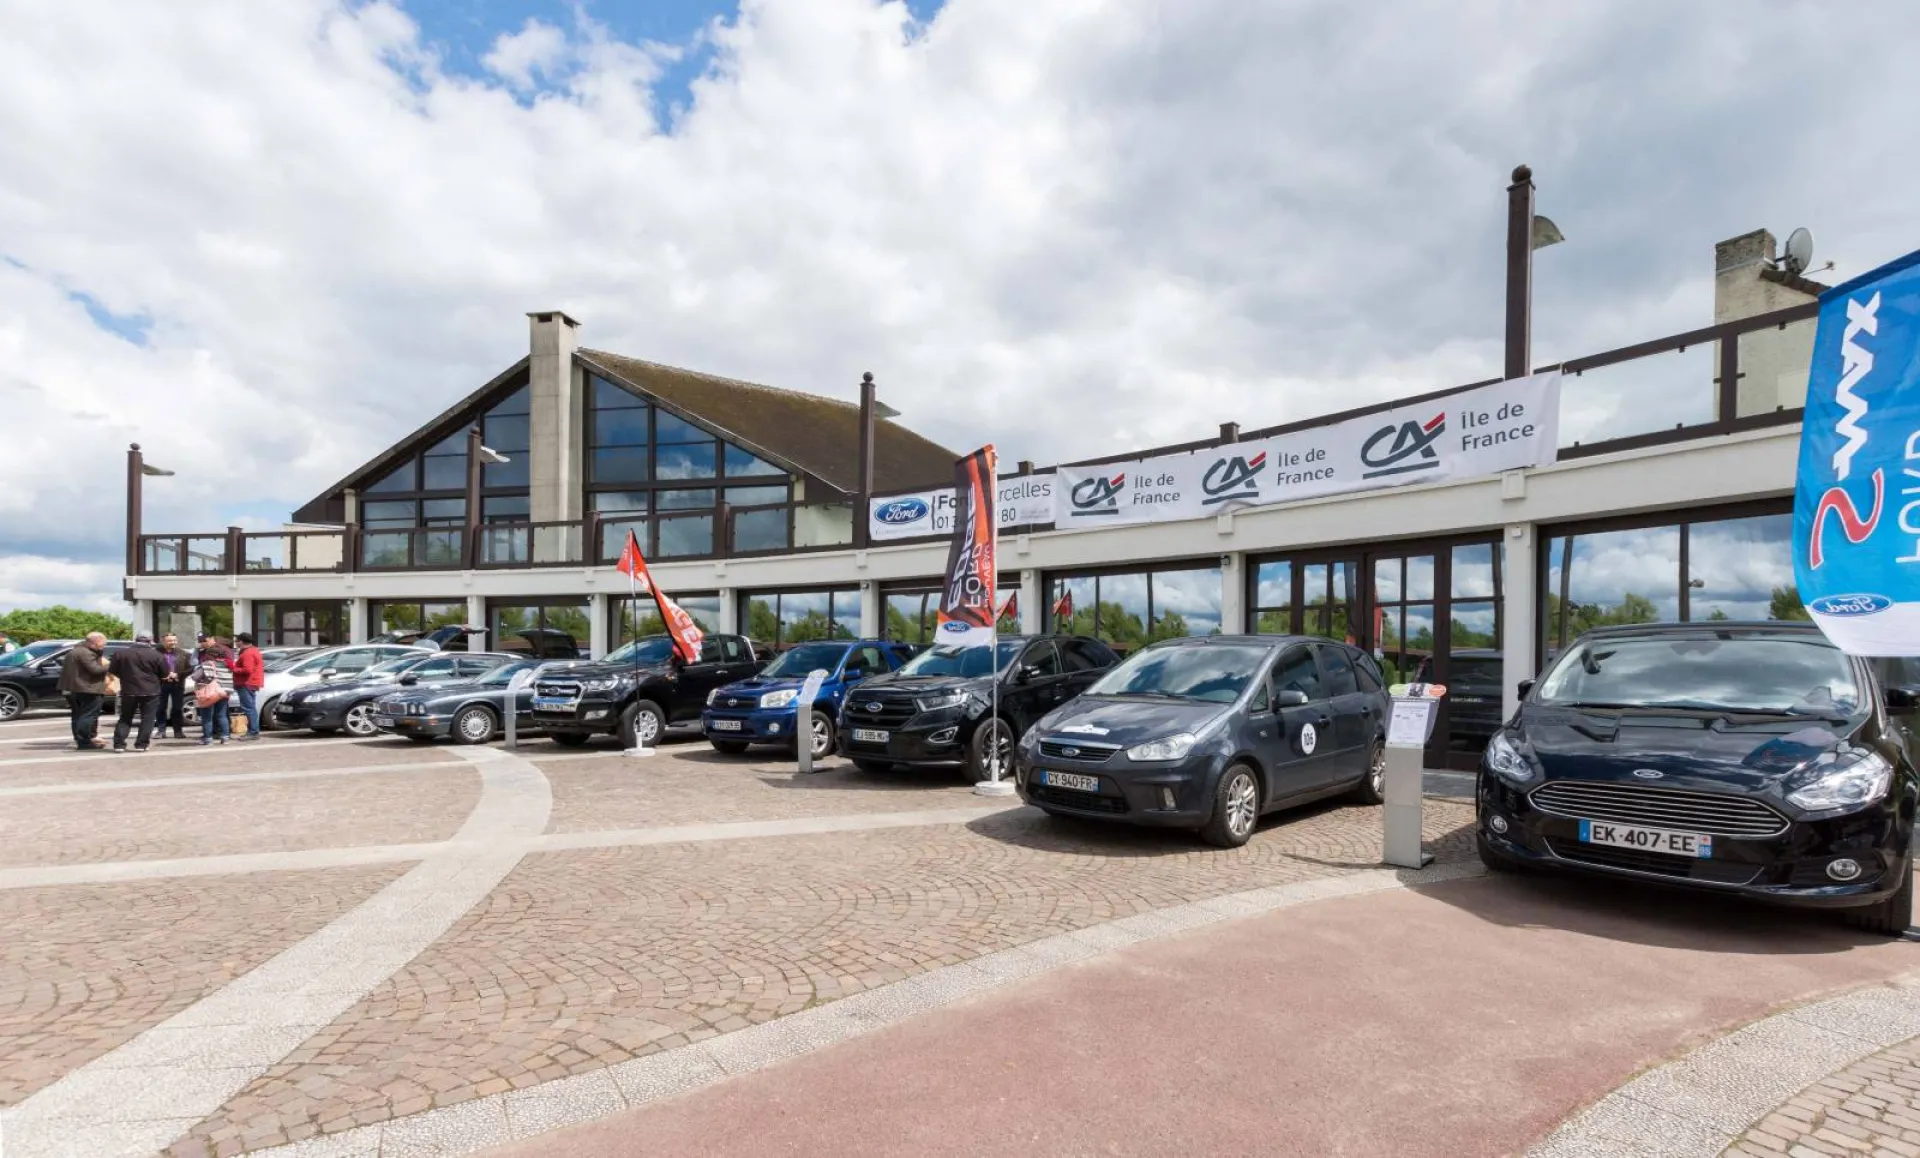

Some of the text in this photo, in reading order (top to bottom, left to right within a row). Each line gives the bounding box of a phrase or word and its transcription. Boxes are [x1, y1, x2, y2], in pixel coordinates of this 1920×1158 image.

[1497, 403, 1524, 420] de
[1462, 424, 1534, 451] France
[1305, 448, 1326, 463] de
[1157, 473, 1175, 486] de
[1277, 467, 1334, 486] France
[1133, 491, 1180, 505] France
[1001, 507, 1016, 522] 80
